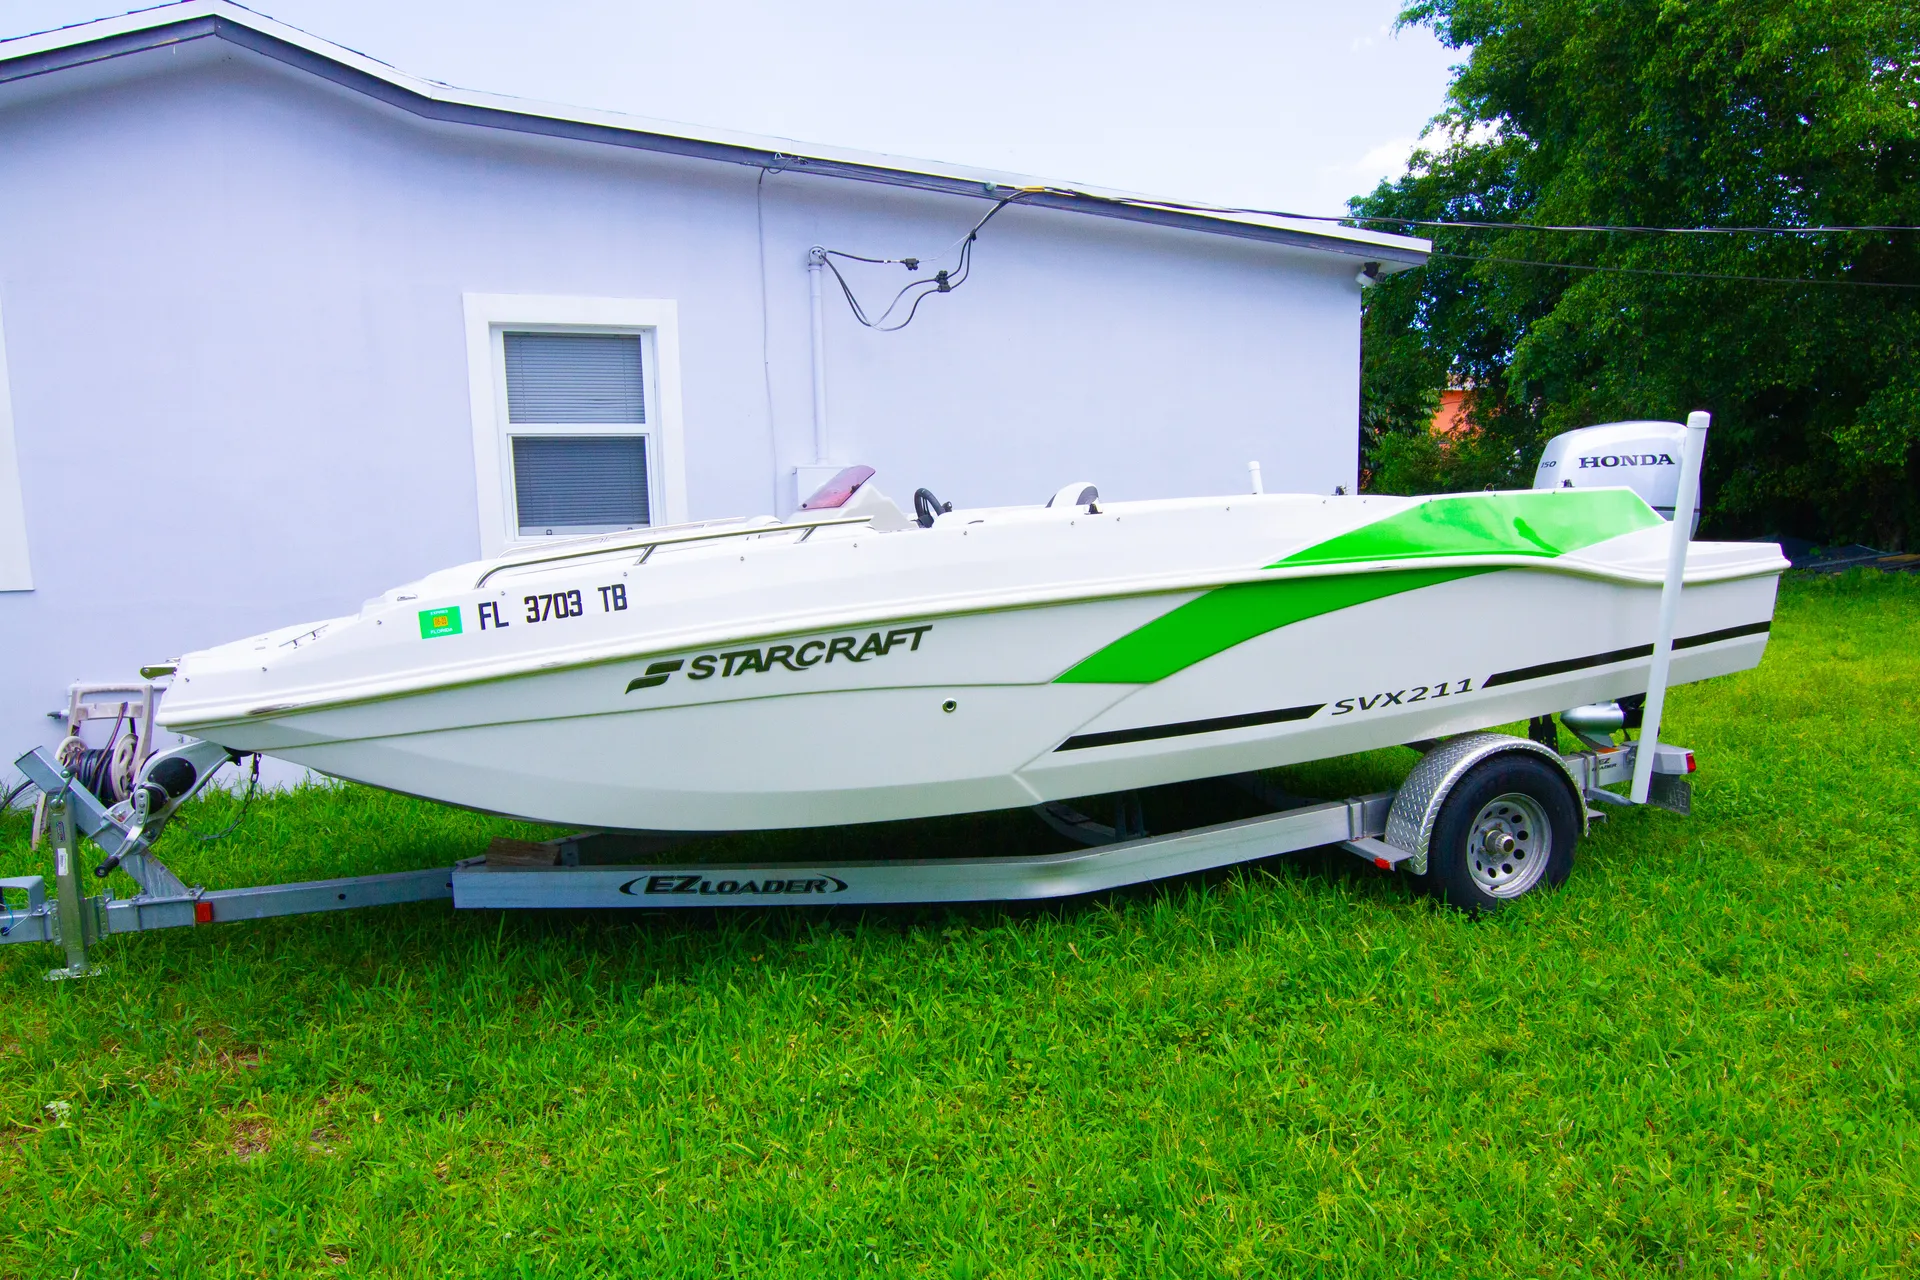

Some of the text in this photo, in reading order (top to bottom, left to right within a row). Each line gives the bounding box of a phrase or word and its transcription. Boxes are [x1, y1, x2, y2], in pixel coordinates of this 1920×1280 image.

[1541, 460, 1557, 468] 150
[1578, 454, 1675, 469] HONDA
[478, 584, 627, 630] FL 3703 TB
[430, 627, 454, 635] FLORIDA
[687, 625, 933, 680] STARCRAFT
[1331, 678, 1473, 715] SVX211
